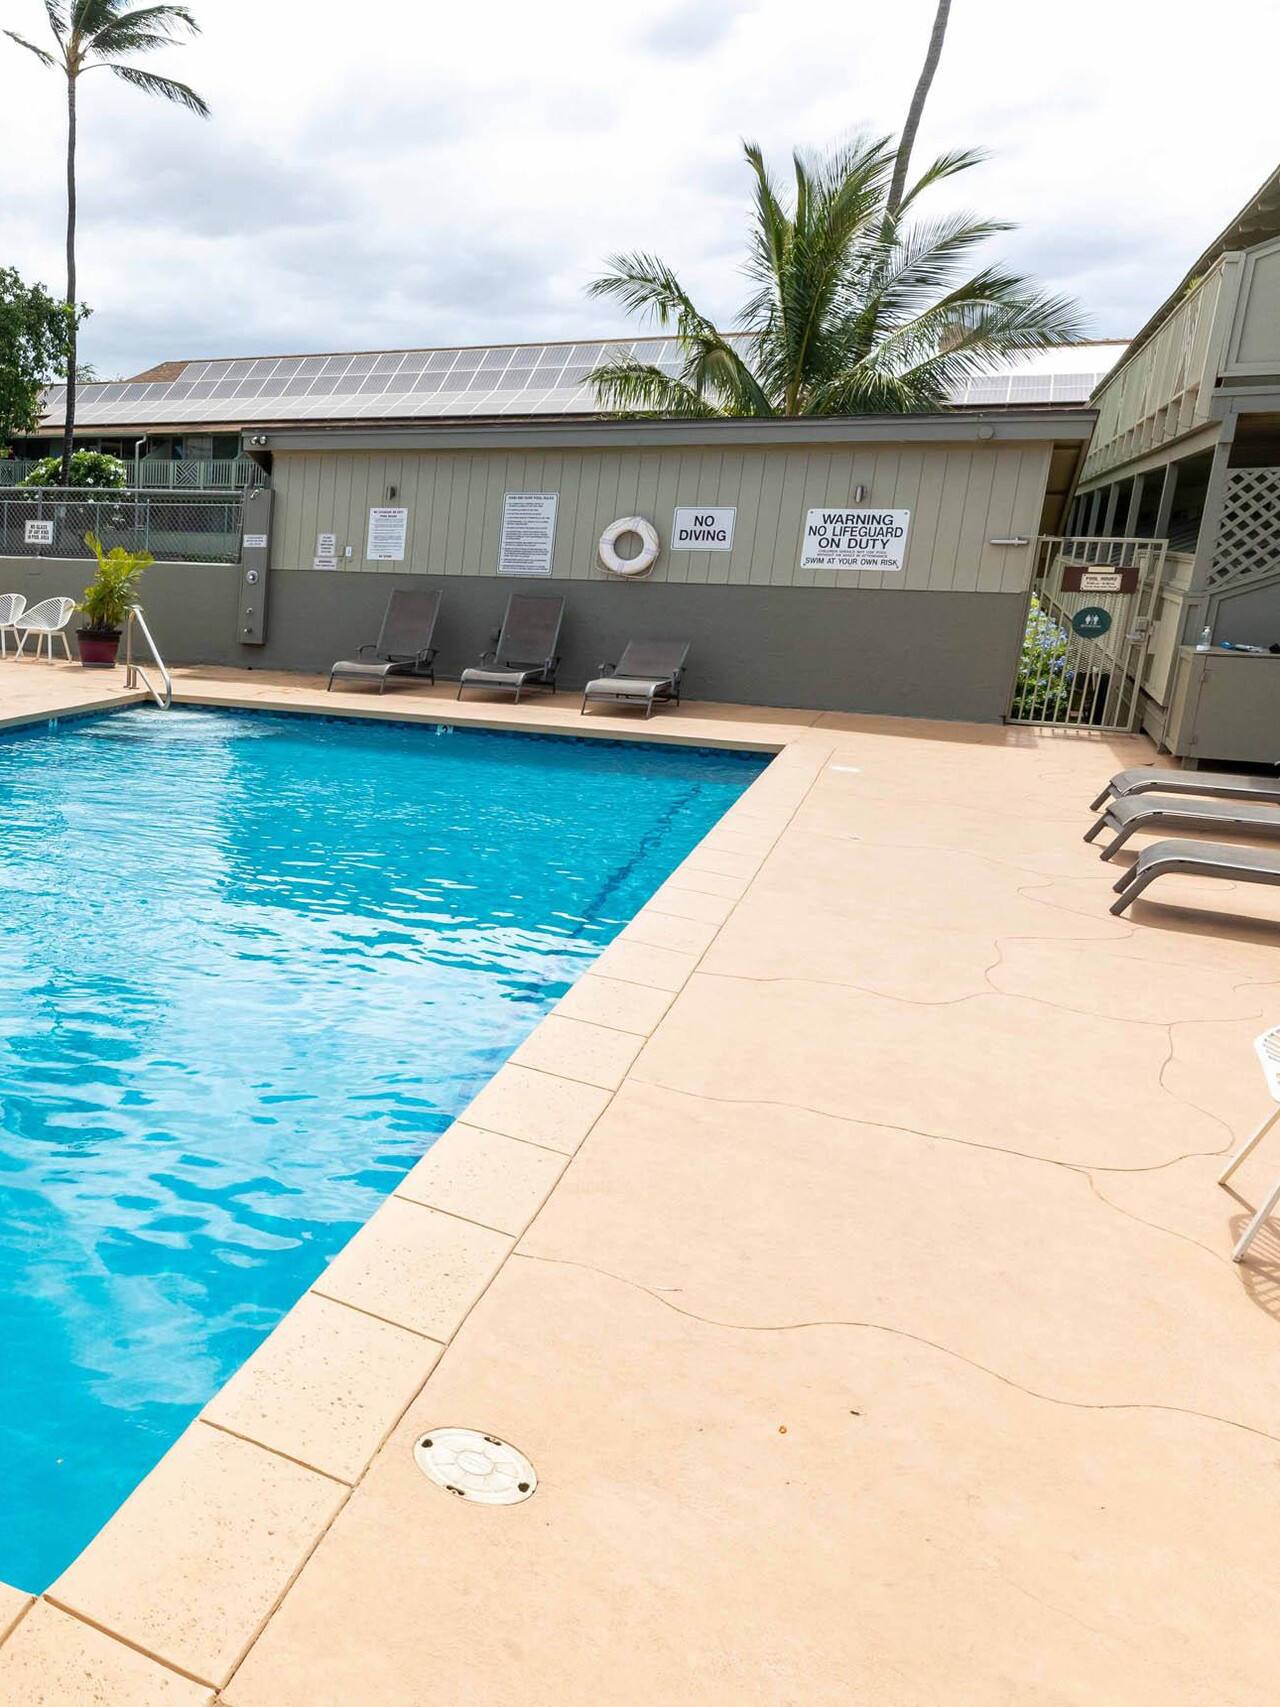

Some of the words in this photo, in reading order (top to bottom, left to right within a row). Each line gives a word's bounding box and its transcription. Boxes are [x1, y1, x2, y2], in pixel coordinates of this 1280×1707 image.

[694, 515, 715, 527] NO
[822, 514, 894, 525] WARNING
[679, 529, 727, 542] DIVING
[808, 525, 827, 536] NO
[832, 526, 904, 538] LIFEGUARD
[818, 537, 840, 549] ON
[847, 538, 890, 549] DUTY
